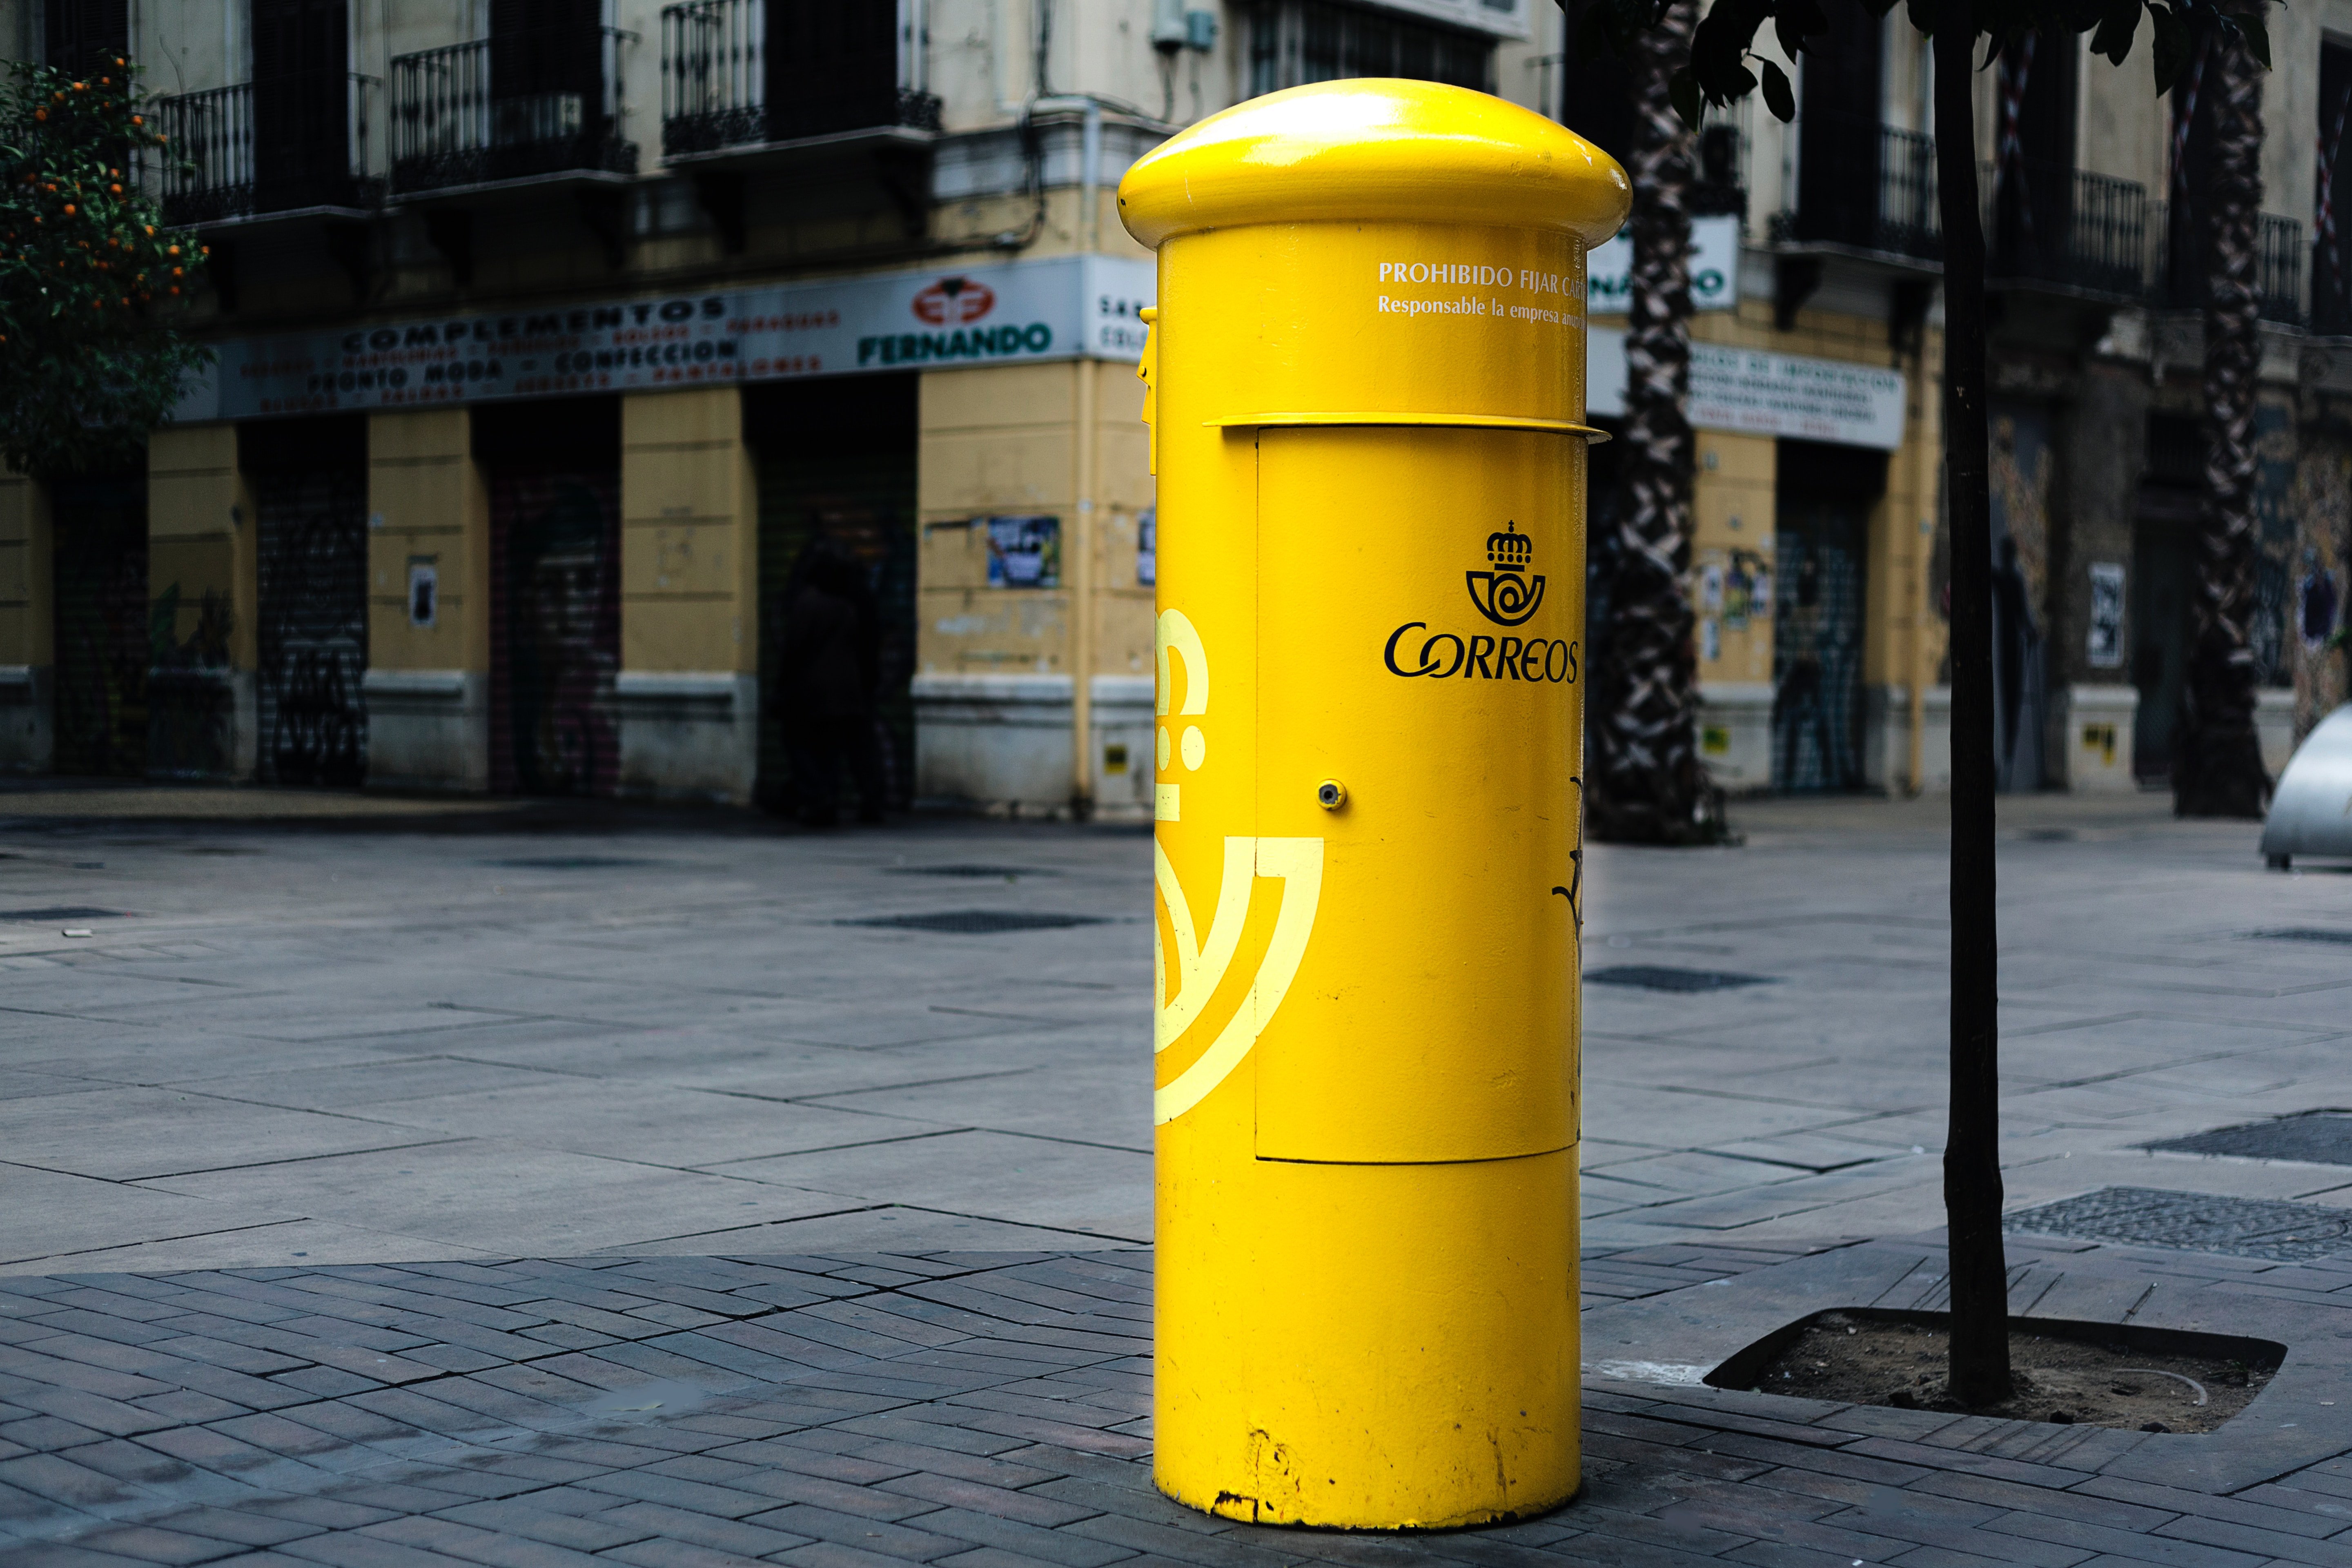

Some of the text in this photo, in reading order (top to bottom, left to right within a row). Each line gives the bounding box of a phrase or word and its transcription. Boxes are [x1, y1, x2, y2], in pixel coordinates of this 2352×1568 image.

[1379, 262, 1512, 287] PROHIBIDO
[1520, 270, 1558, 294] FIJAR
[342, 297, 725, 353] COMPLEMENTOS
[1379, 295, 1486, 317] Responsable
[1492, 298, 1504, 316] la
[1510, 305, 1559, 324] empresa
[307, 340, 737, 392] PRONTO MODA CONFECCION
[858, 323, 1052, 365] FERNANDO
[1384, 621, 1578, 684] CORREOS
